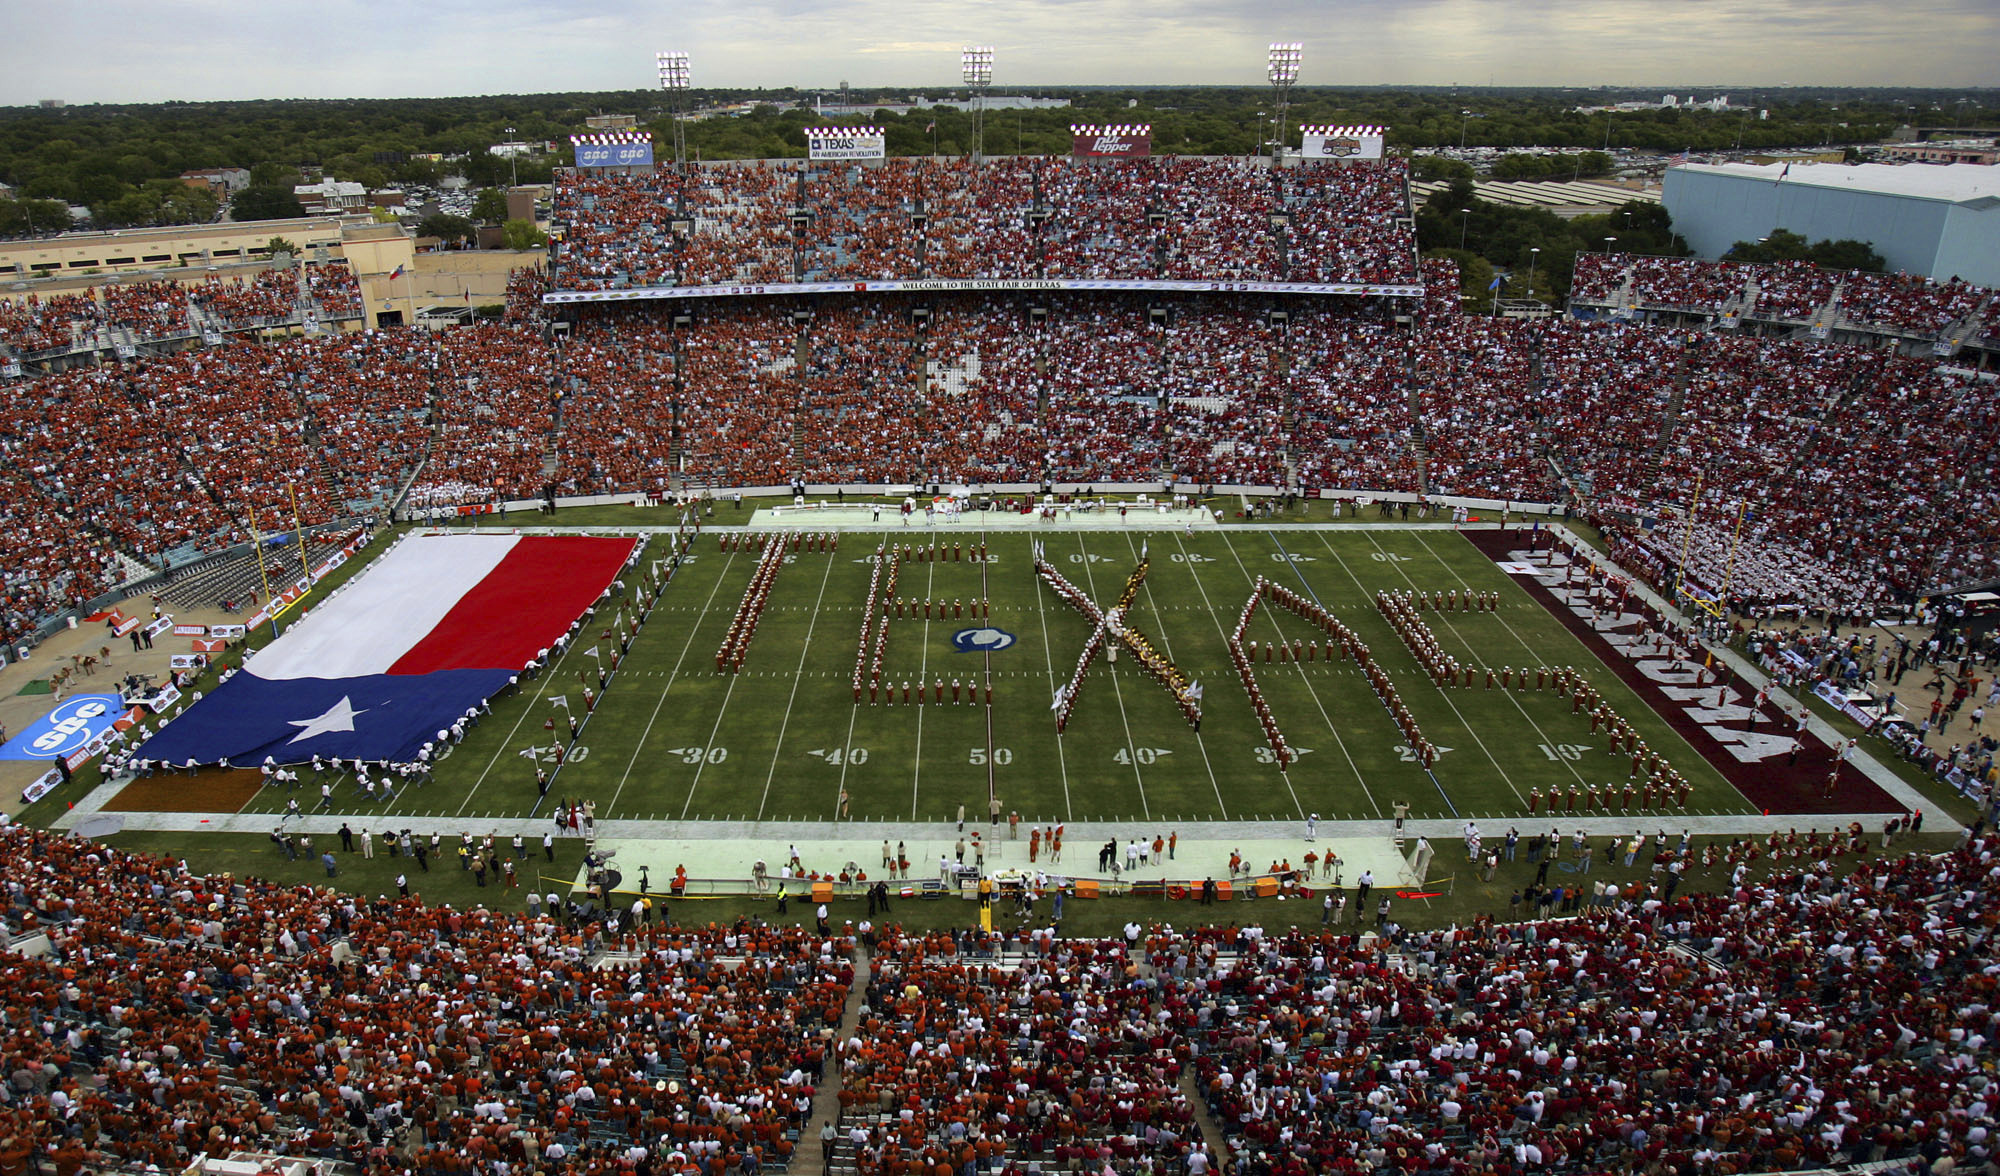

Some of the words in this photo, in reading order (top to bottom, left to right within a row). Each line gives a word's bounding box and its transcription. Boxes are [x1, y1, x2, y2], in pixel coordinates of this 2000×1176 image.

[823, 138, 855, 149] TEXAS
[1092, 137, 1133, 154] Pepper
[1106, 134, 1121, 143] Dr
[583, 150, 609, 160] SBC
[619, 149, 645, 159] SBC
[1069, 554, 1101, 563] 40
[1170, 554, 1203, 563] 30
[1271, 553, 1304, 563] 20
[1371, 552, 1403, 562] 10
[32, 702, 107, 751] SBC
[542, 746, 589, 762] 20
[683, 747, 728, 764] 30
[825, 748, 869, 765] 40
[969, 748, 1013, 765] 50
[1113, 748, 1156, 765] 40
[1254, 747, 1300, 764] 30
[1537, 744, 1582, 761] 10
